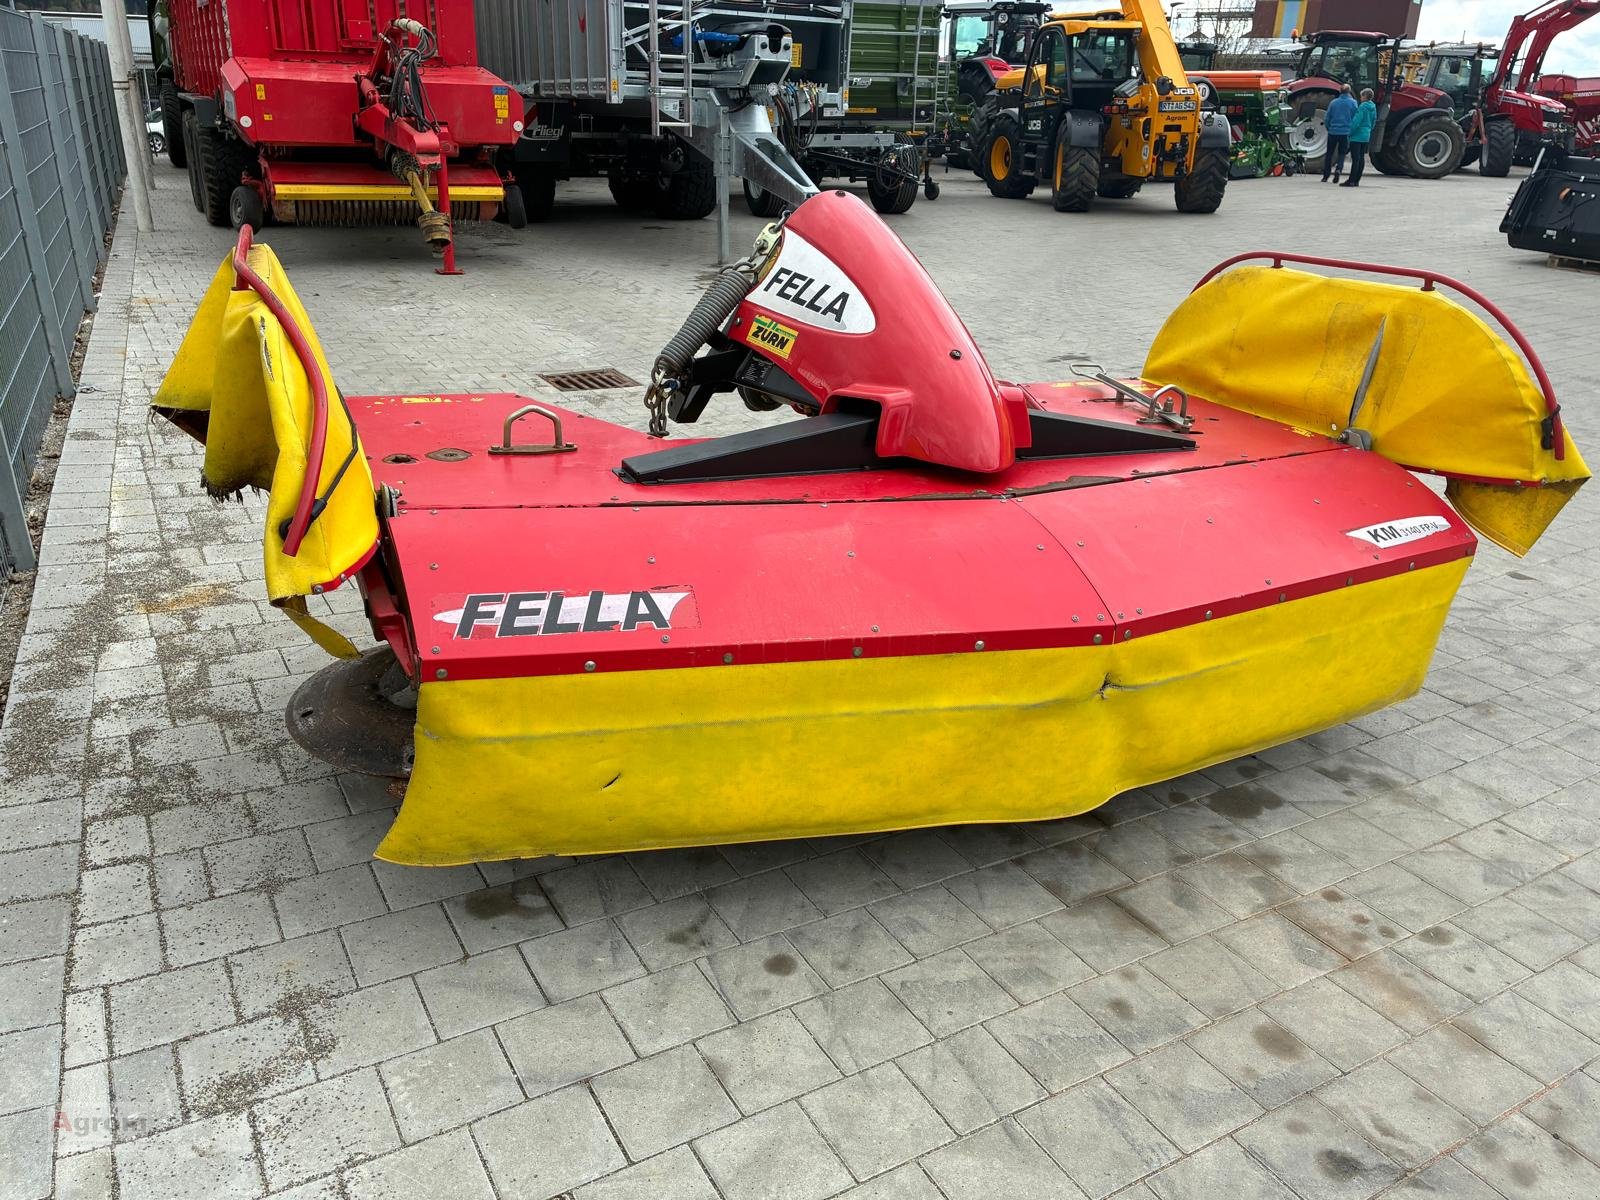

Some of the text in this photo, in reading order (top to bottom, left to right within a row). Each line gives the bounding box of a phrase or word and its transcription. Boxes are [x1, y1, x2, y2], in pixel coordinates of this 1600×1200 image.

[532, 124, 565, 139] Fliegl
[1028, 120, 1041, 130] JCB
[763, 267, 850, 323] FELLA
[1366, 525, 1401, 543] KM
[1400, 526, 1421, 537] 3140
[452, 590, 672, 640] FELLA
